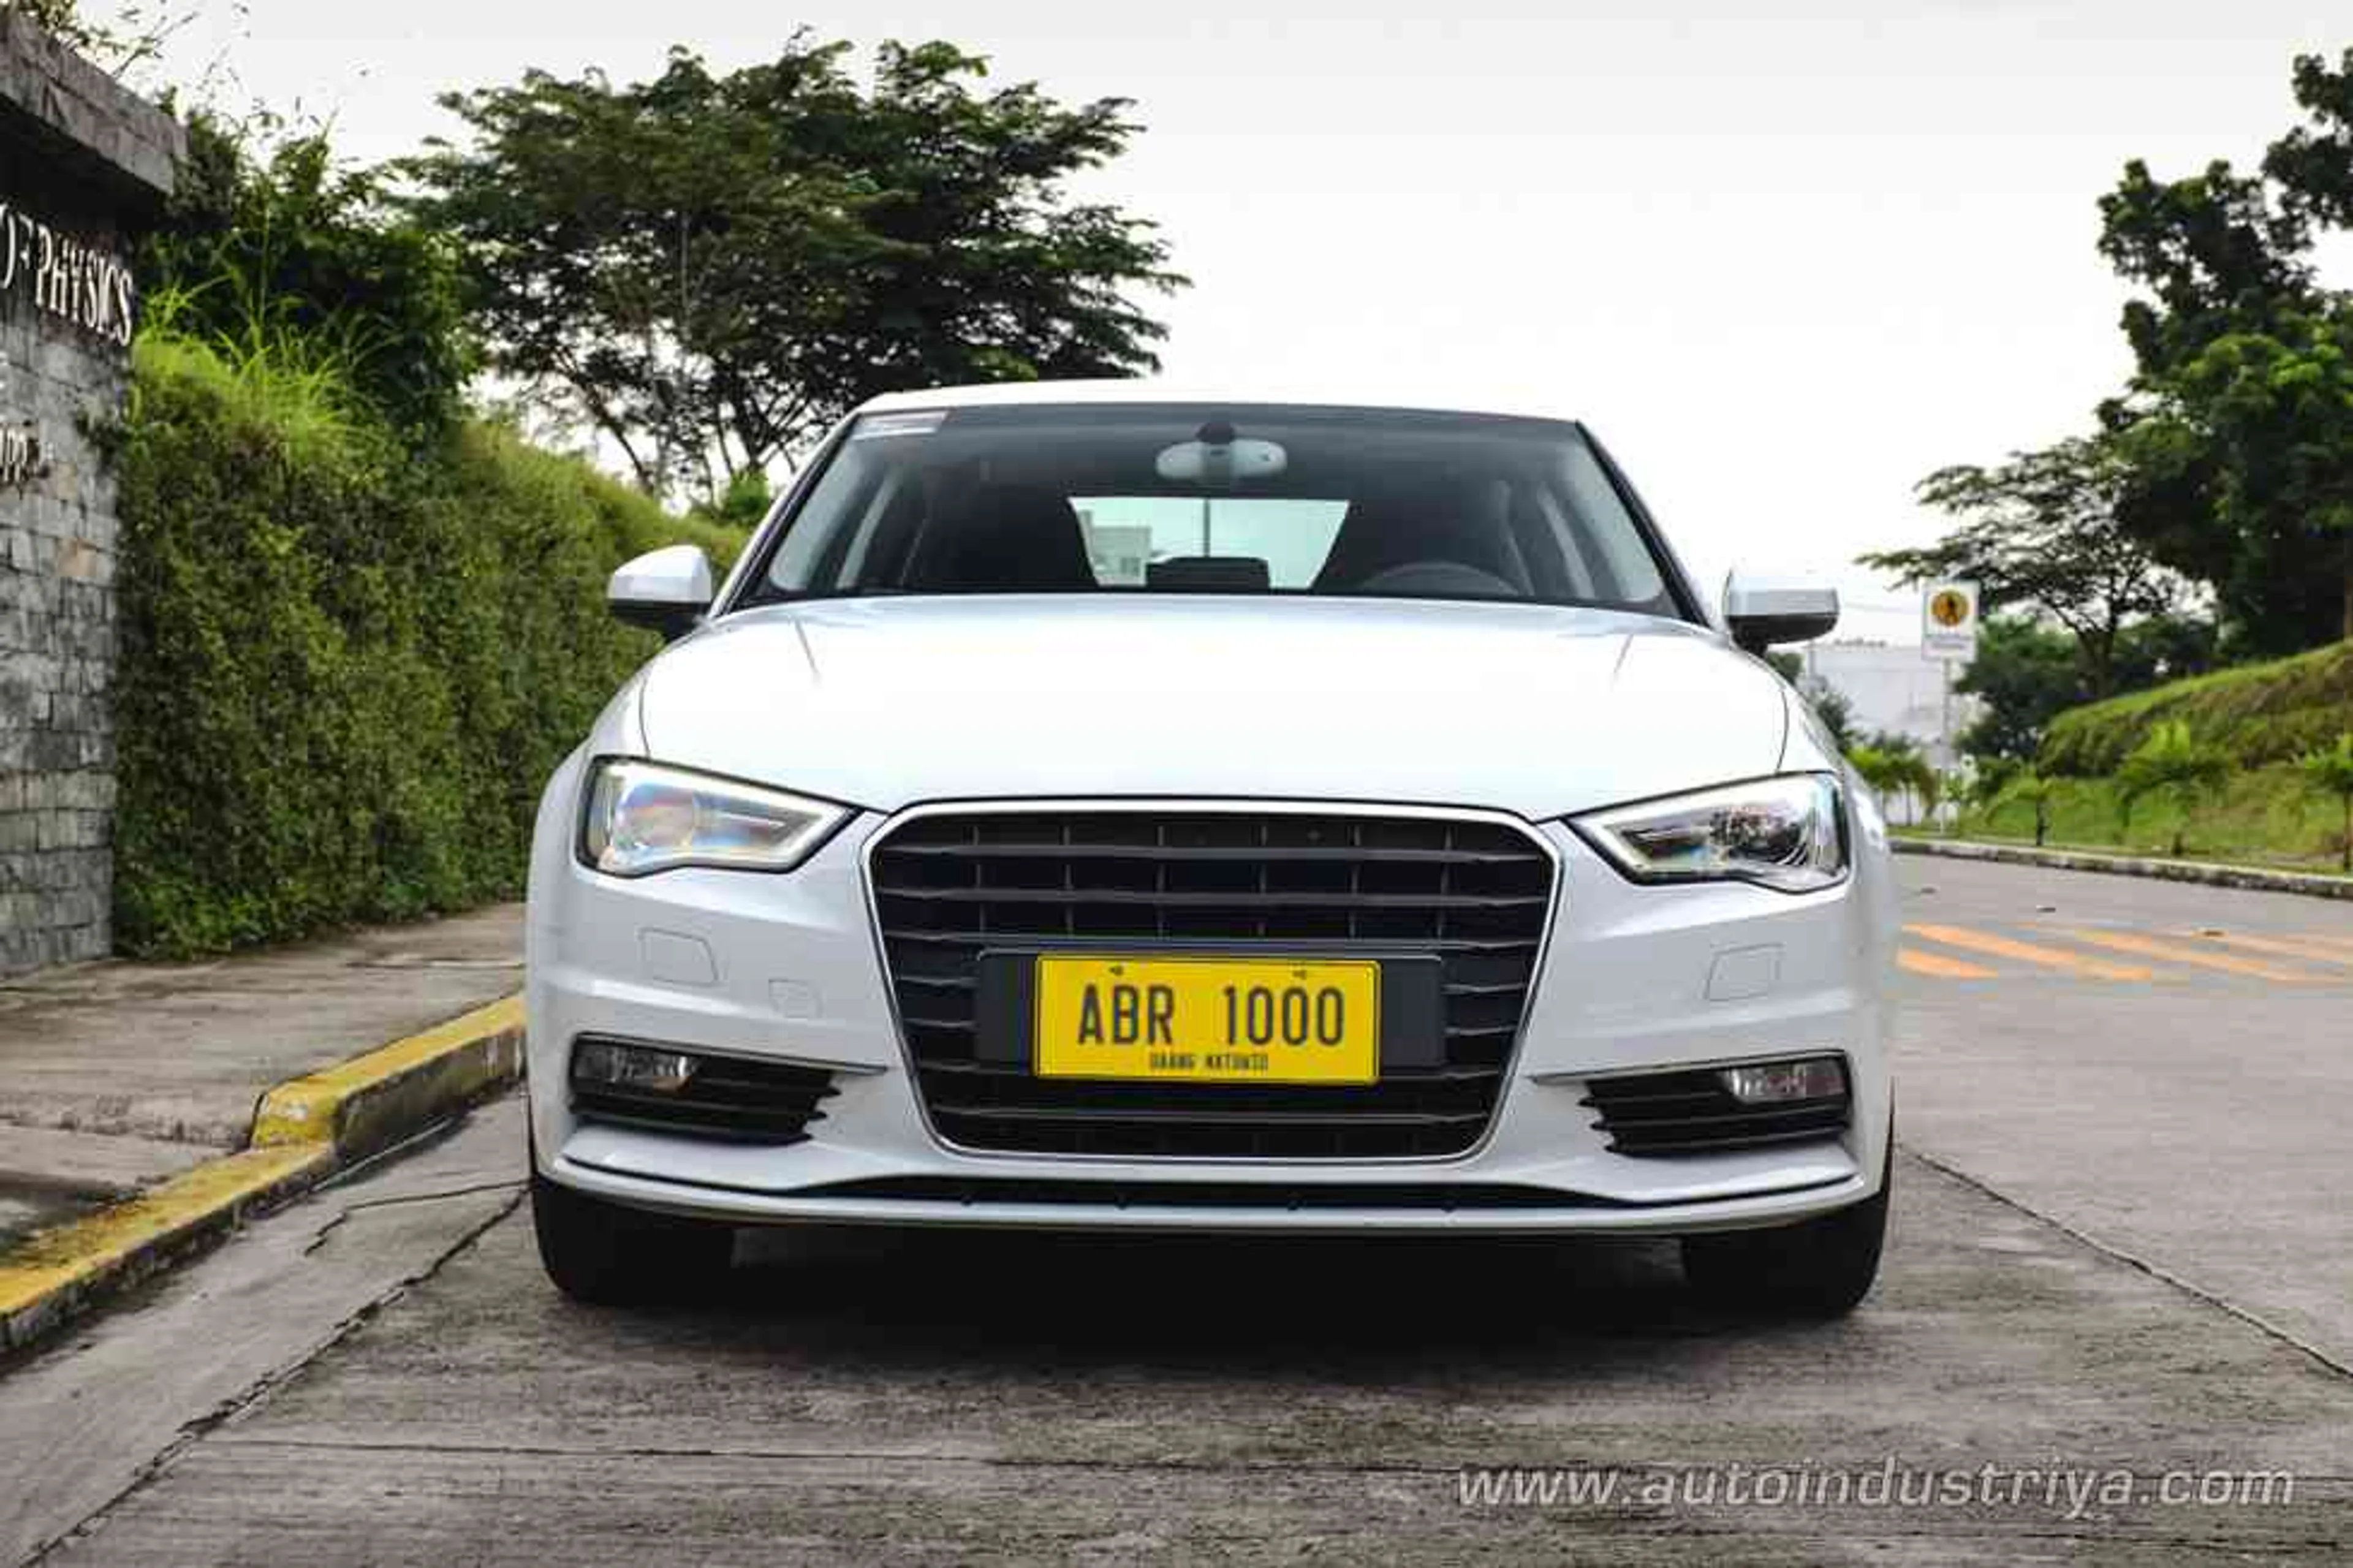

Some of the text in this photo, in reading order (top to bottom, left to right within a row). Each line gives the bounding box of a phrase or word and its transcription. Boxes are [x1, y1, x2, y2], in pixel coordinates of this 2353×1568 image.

[35, 222, 133, 346] PHYSICS
[1077, 983, 1345, 1047] ABR 1000
